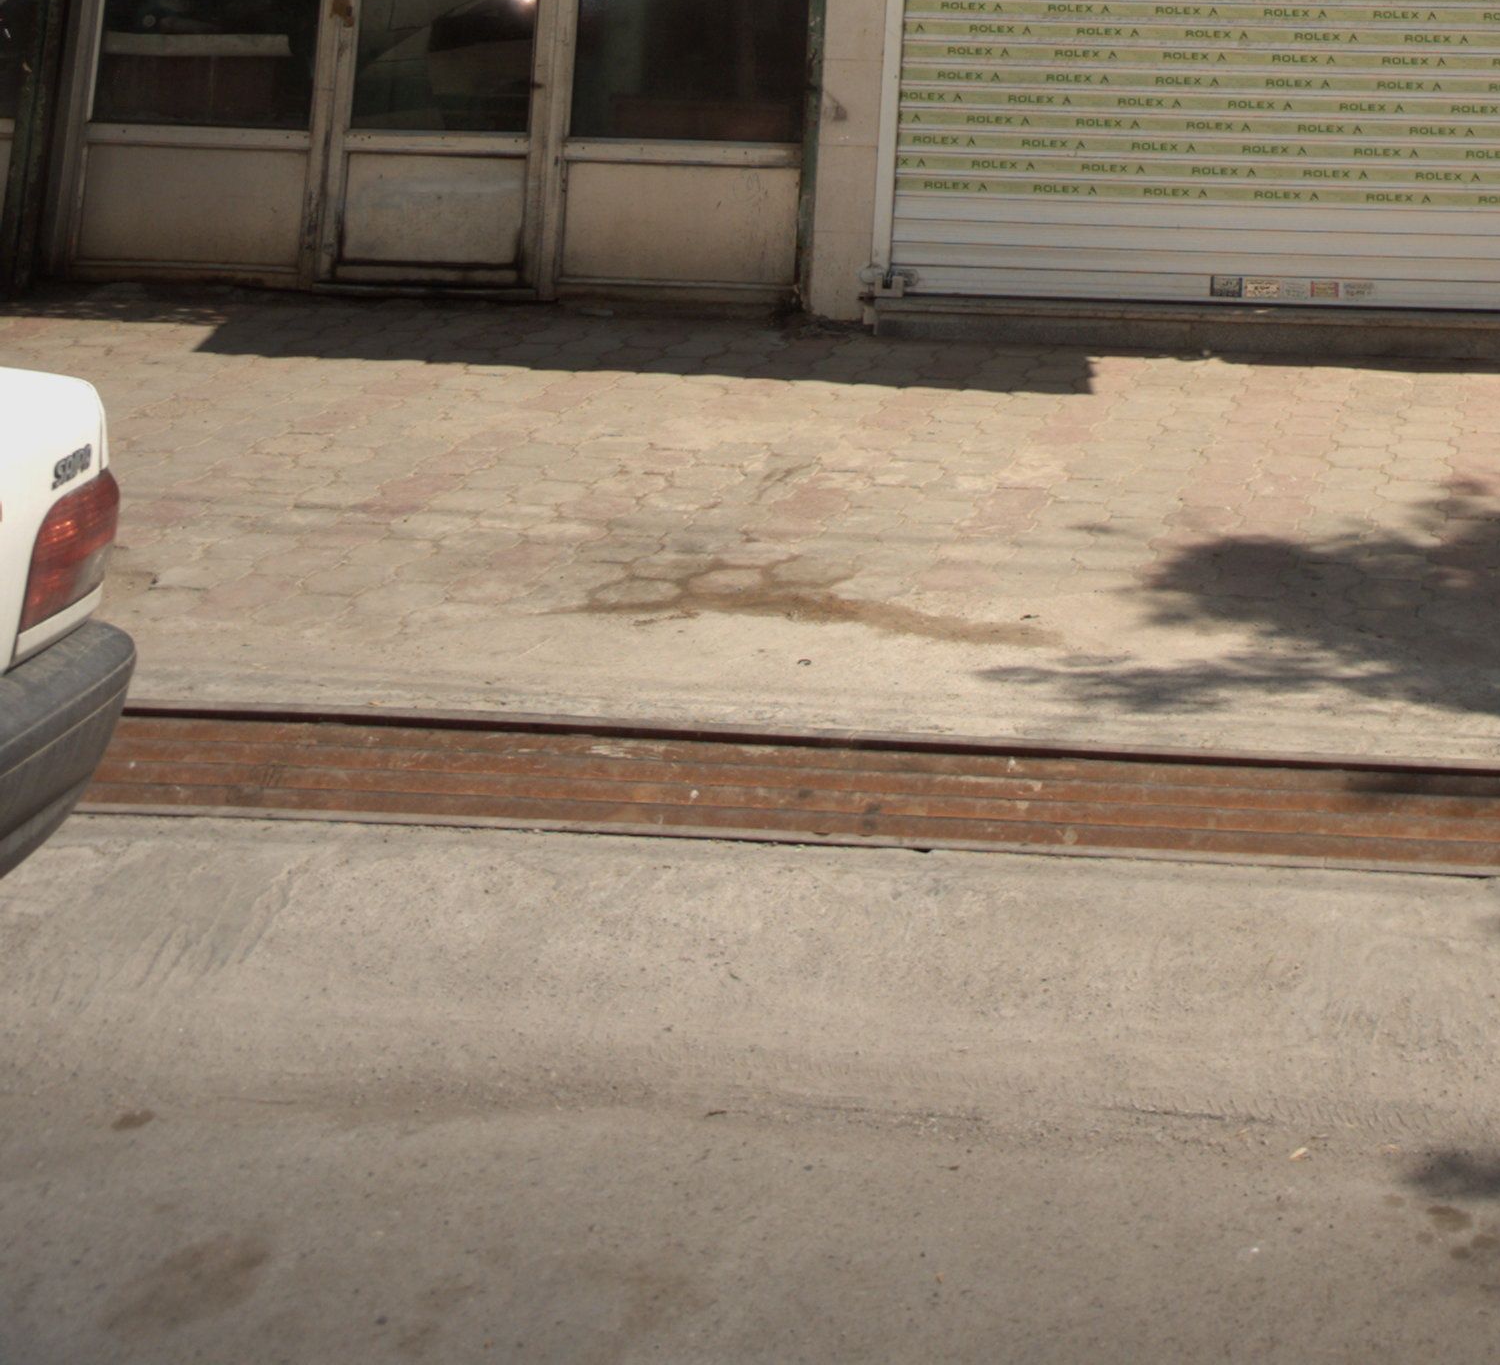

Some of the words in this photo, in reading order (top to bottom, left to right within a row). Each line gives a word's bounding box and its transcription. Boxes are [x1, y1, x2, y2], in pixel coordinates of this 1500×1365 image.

[940, 1, 986, 11] ROLEX
[1047, 3, 1095, 13] ROLEX
[1263, 8, 1311, 18] ROLEX
[1184, 29, 1232, 39] ROLEX
[1294, 32, 1342, 42] ROLEX
[1404, 34, 1452, 44] ROLEX
[1054, 49, 1100, 59] ROLEX
[1162, 51, 1210, 61] ROLEX
[1382, 56, 1430, 66] ROLEX
[1045, 73, 1093, 83] ROLEX
[1155, 76, 1203, 86] ROLEX
[1377, 80, 1425, 90] ROLEX
[1116, 97, 1164, 107] ROLEX
[1228, 100, 1276, 110] ROLEX
[1339, 102, 1387, 112] ROLEX
[1450, 104, 1500, 114] ROLEX
[965, 115, 1013, 125] ROLEX
[1185, 121, 1233, 131] ROLEX
[1409, 126, 1457, 136] ROLEX
[911, 135, 959, 145] ROLEX
[1241, 144, 1289, 153] ROLEX
[1353, 147, 1401, 157] ROLEX
[971, 159, 1019, 169] ROLEX
[1081, 163, 1129, 173] ROLEX
[1303, 169, 1351, 179] ROLEX
[1415, 171, 1463, 181] ROLEX
[1033, 184, 1081, 194] ROLEX
[1143, 187, 1191, 197] ROLEX
[1365, 193, 1413, 203] ROLEX
